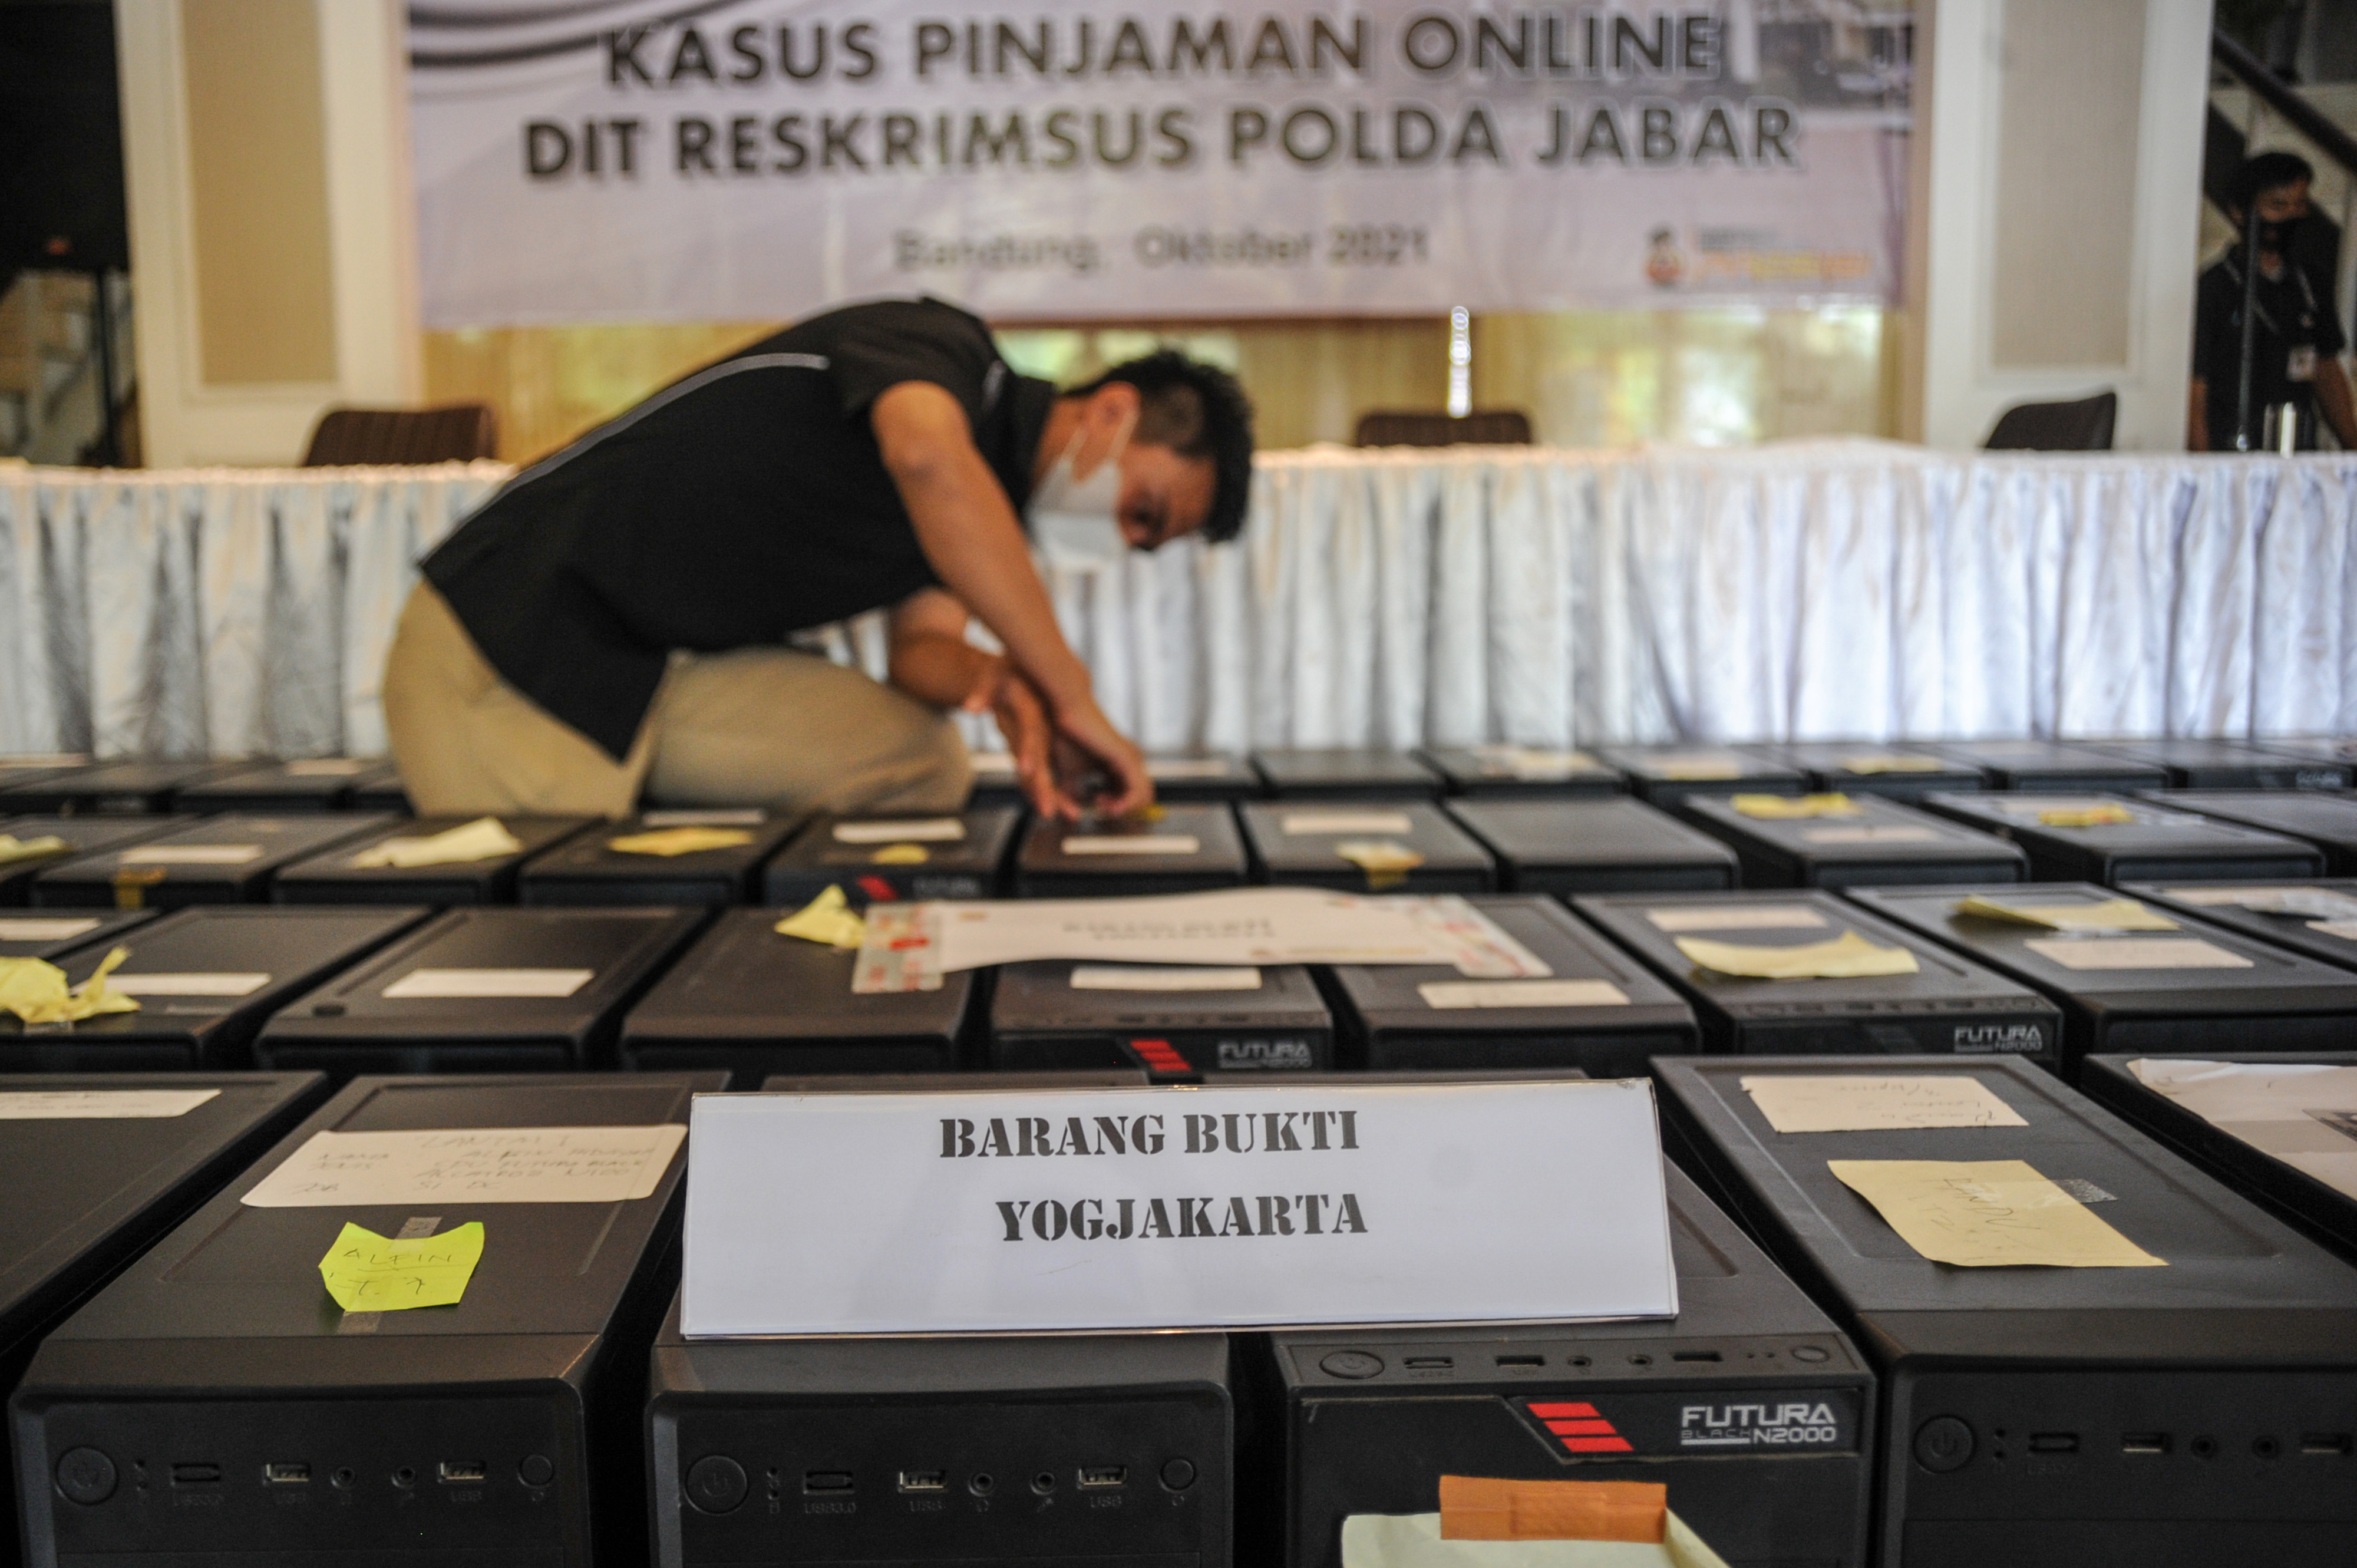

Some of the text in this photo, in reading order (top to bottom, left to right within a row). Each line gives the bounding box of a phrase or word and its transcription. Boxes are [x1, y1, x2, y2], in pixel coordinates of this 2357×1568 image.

[606, 13, 1716, 87] KASUS PINJAMAN ONLINE
[523, 104, 1801, 180] DIT RESKRIMSUS POLDA JABAR
[1954, 1025, 2042, 1042] FUTURA
[939, 1110, 1360, 1158] BARANG BUKTI
[996, 1194, 1369, 1242] YOGJAKARTA
[1681, 1403, 1836, 1428] FUTURA
[1681, 1426, 1837, 1444] BLACK N2000
